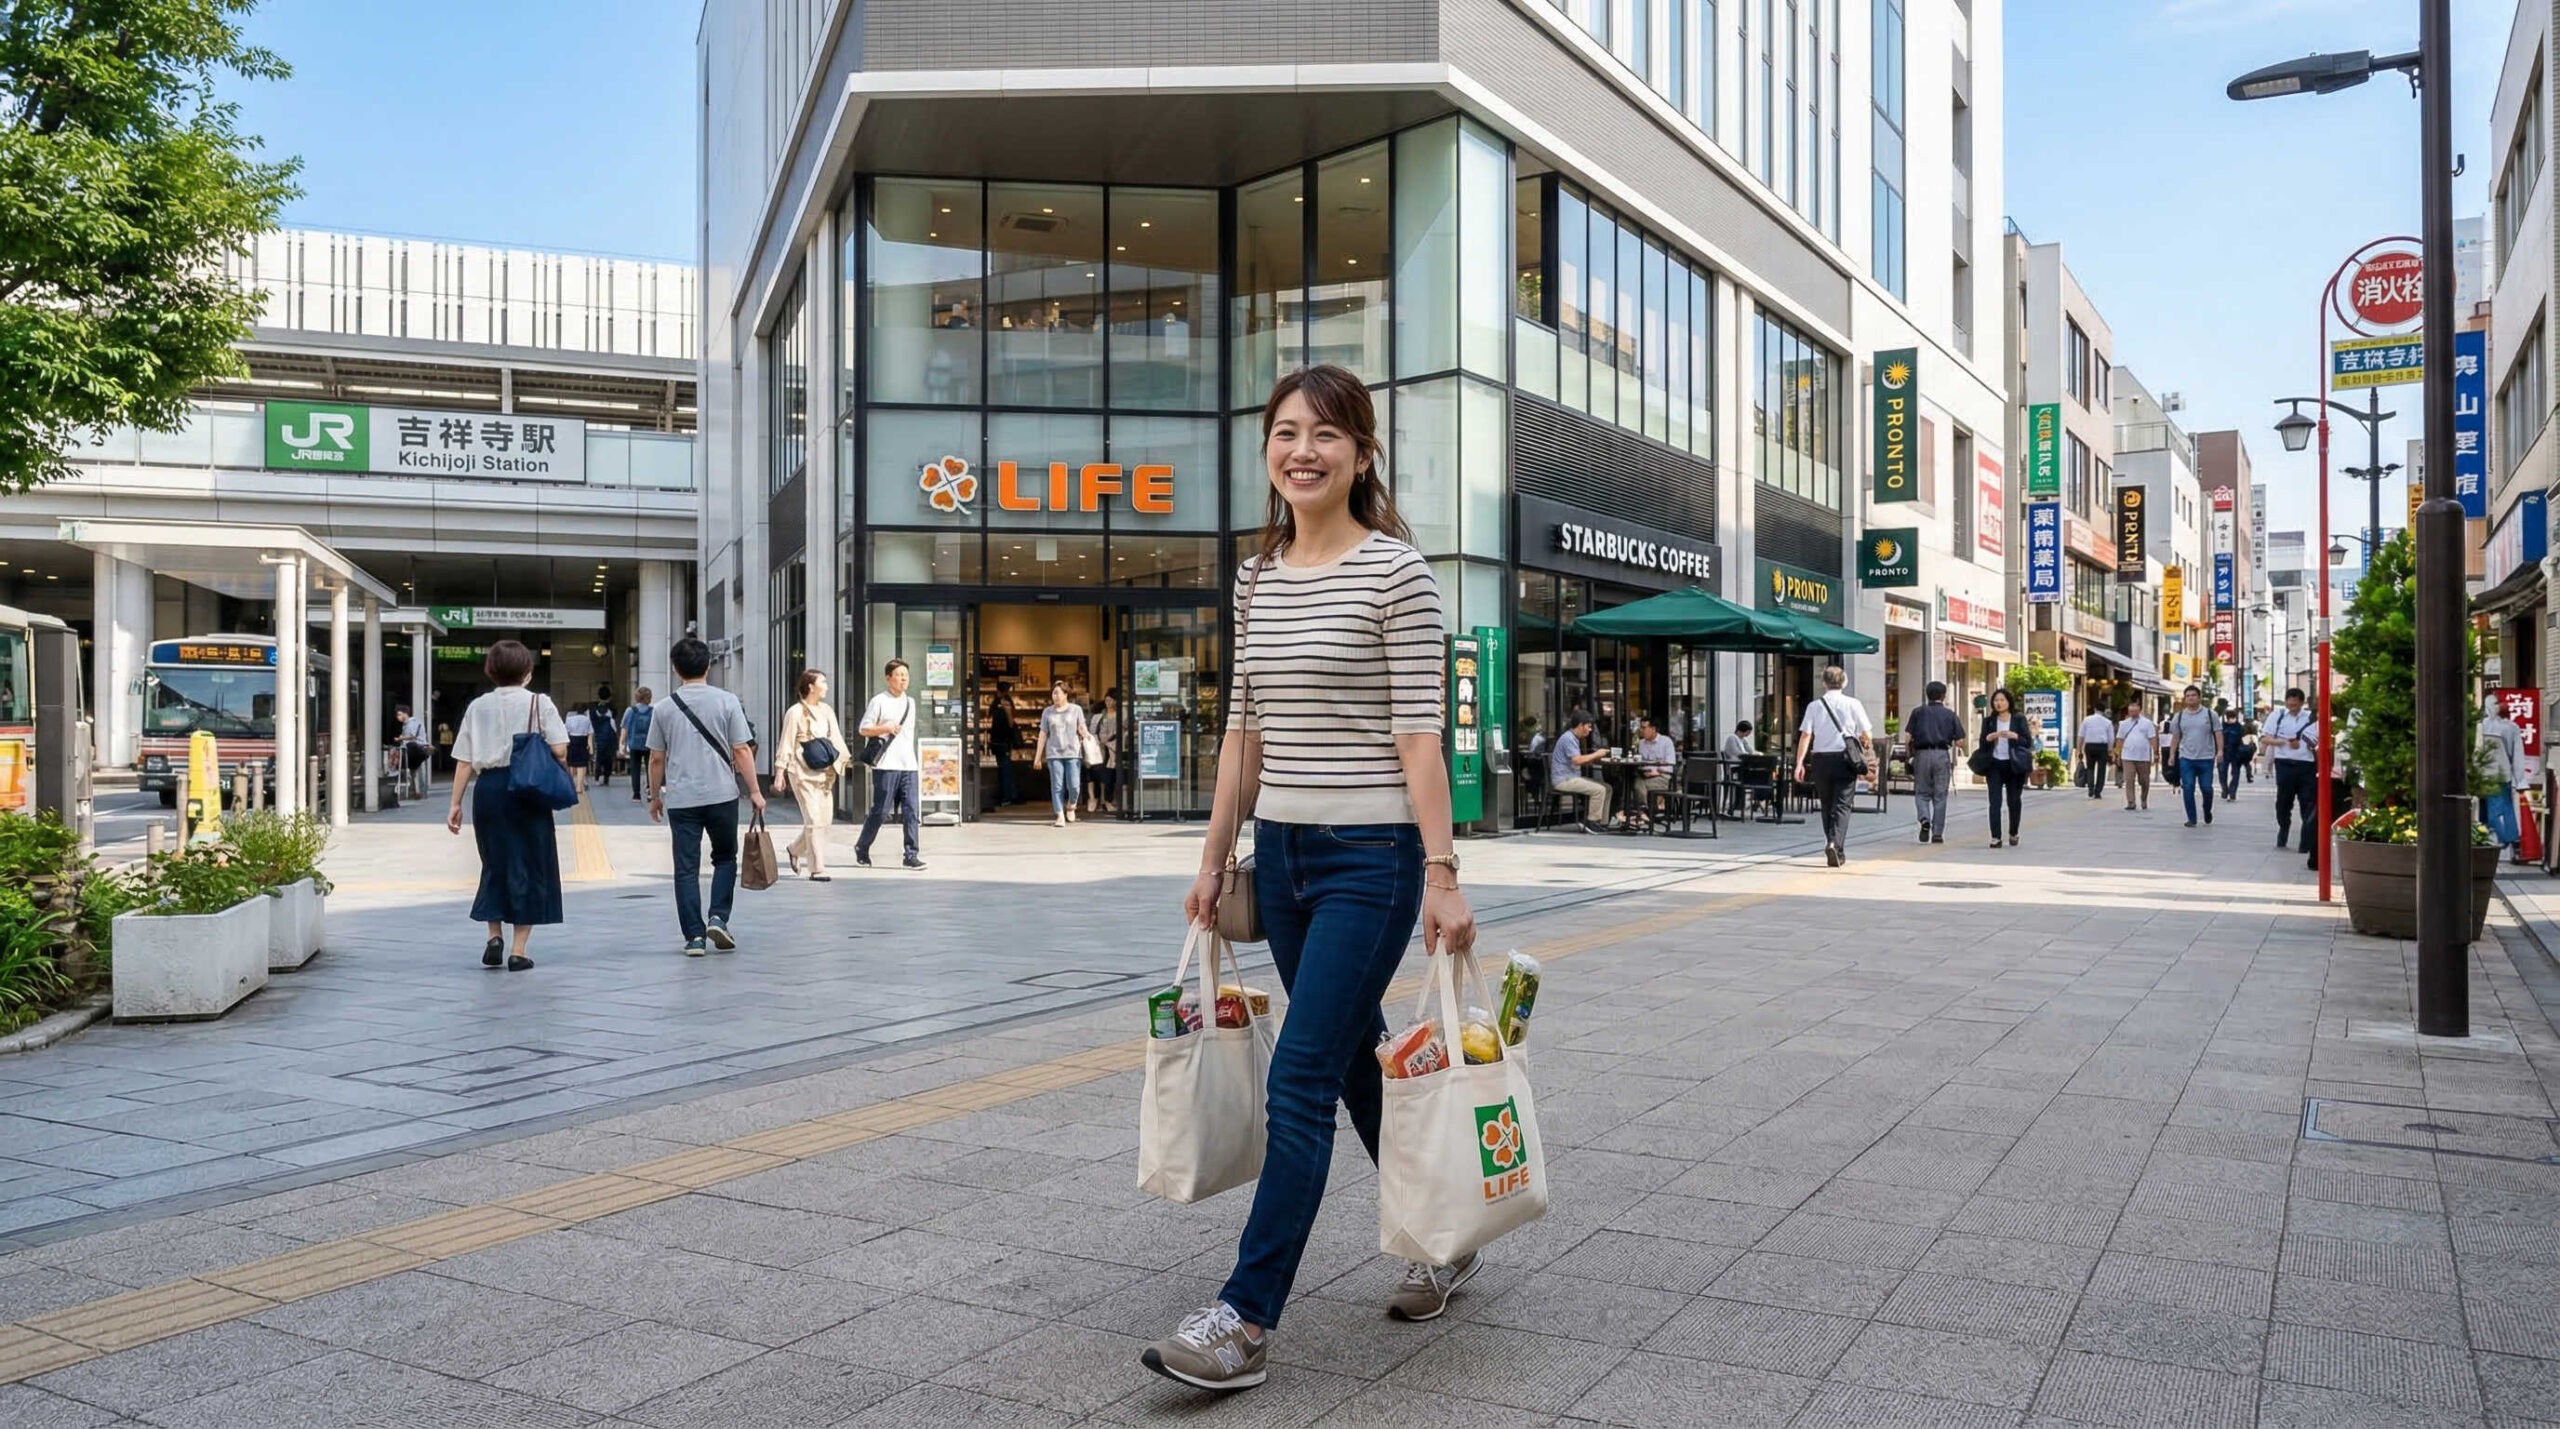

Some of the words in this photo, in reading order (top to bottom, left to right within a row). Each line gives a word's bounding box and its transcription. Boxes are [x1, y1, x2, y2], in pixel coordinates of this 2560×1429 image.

[281, 412, 355, 450] JR
[397, 415, 556, 454] 吉祥寺駅
[1887, 397, 1905, 489] PRONTO
[398, 450, 476, 473] Kichijoji
[482, 455, 550, 473] Station
[997, 460, 1175, 514] LIFE
[1561, 522, 1657, 568] STARBUCKS
[1659, 545, 1710, 579] COFFEE
[1786, 575, 1828, 605] PRONTO
[1868, 567, 1909, 577] PRONTO
[1483, 1166, 1530, 1200] LIFE
